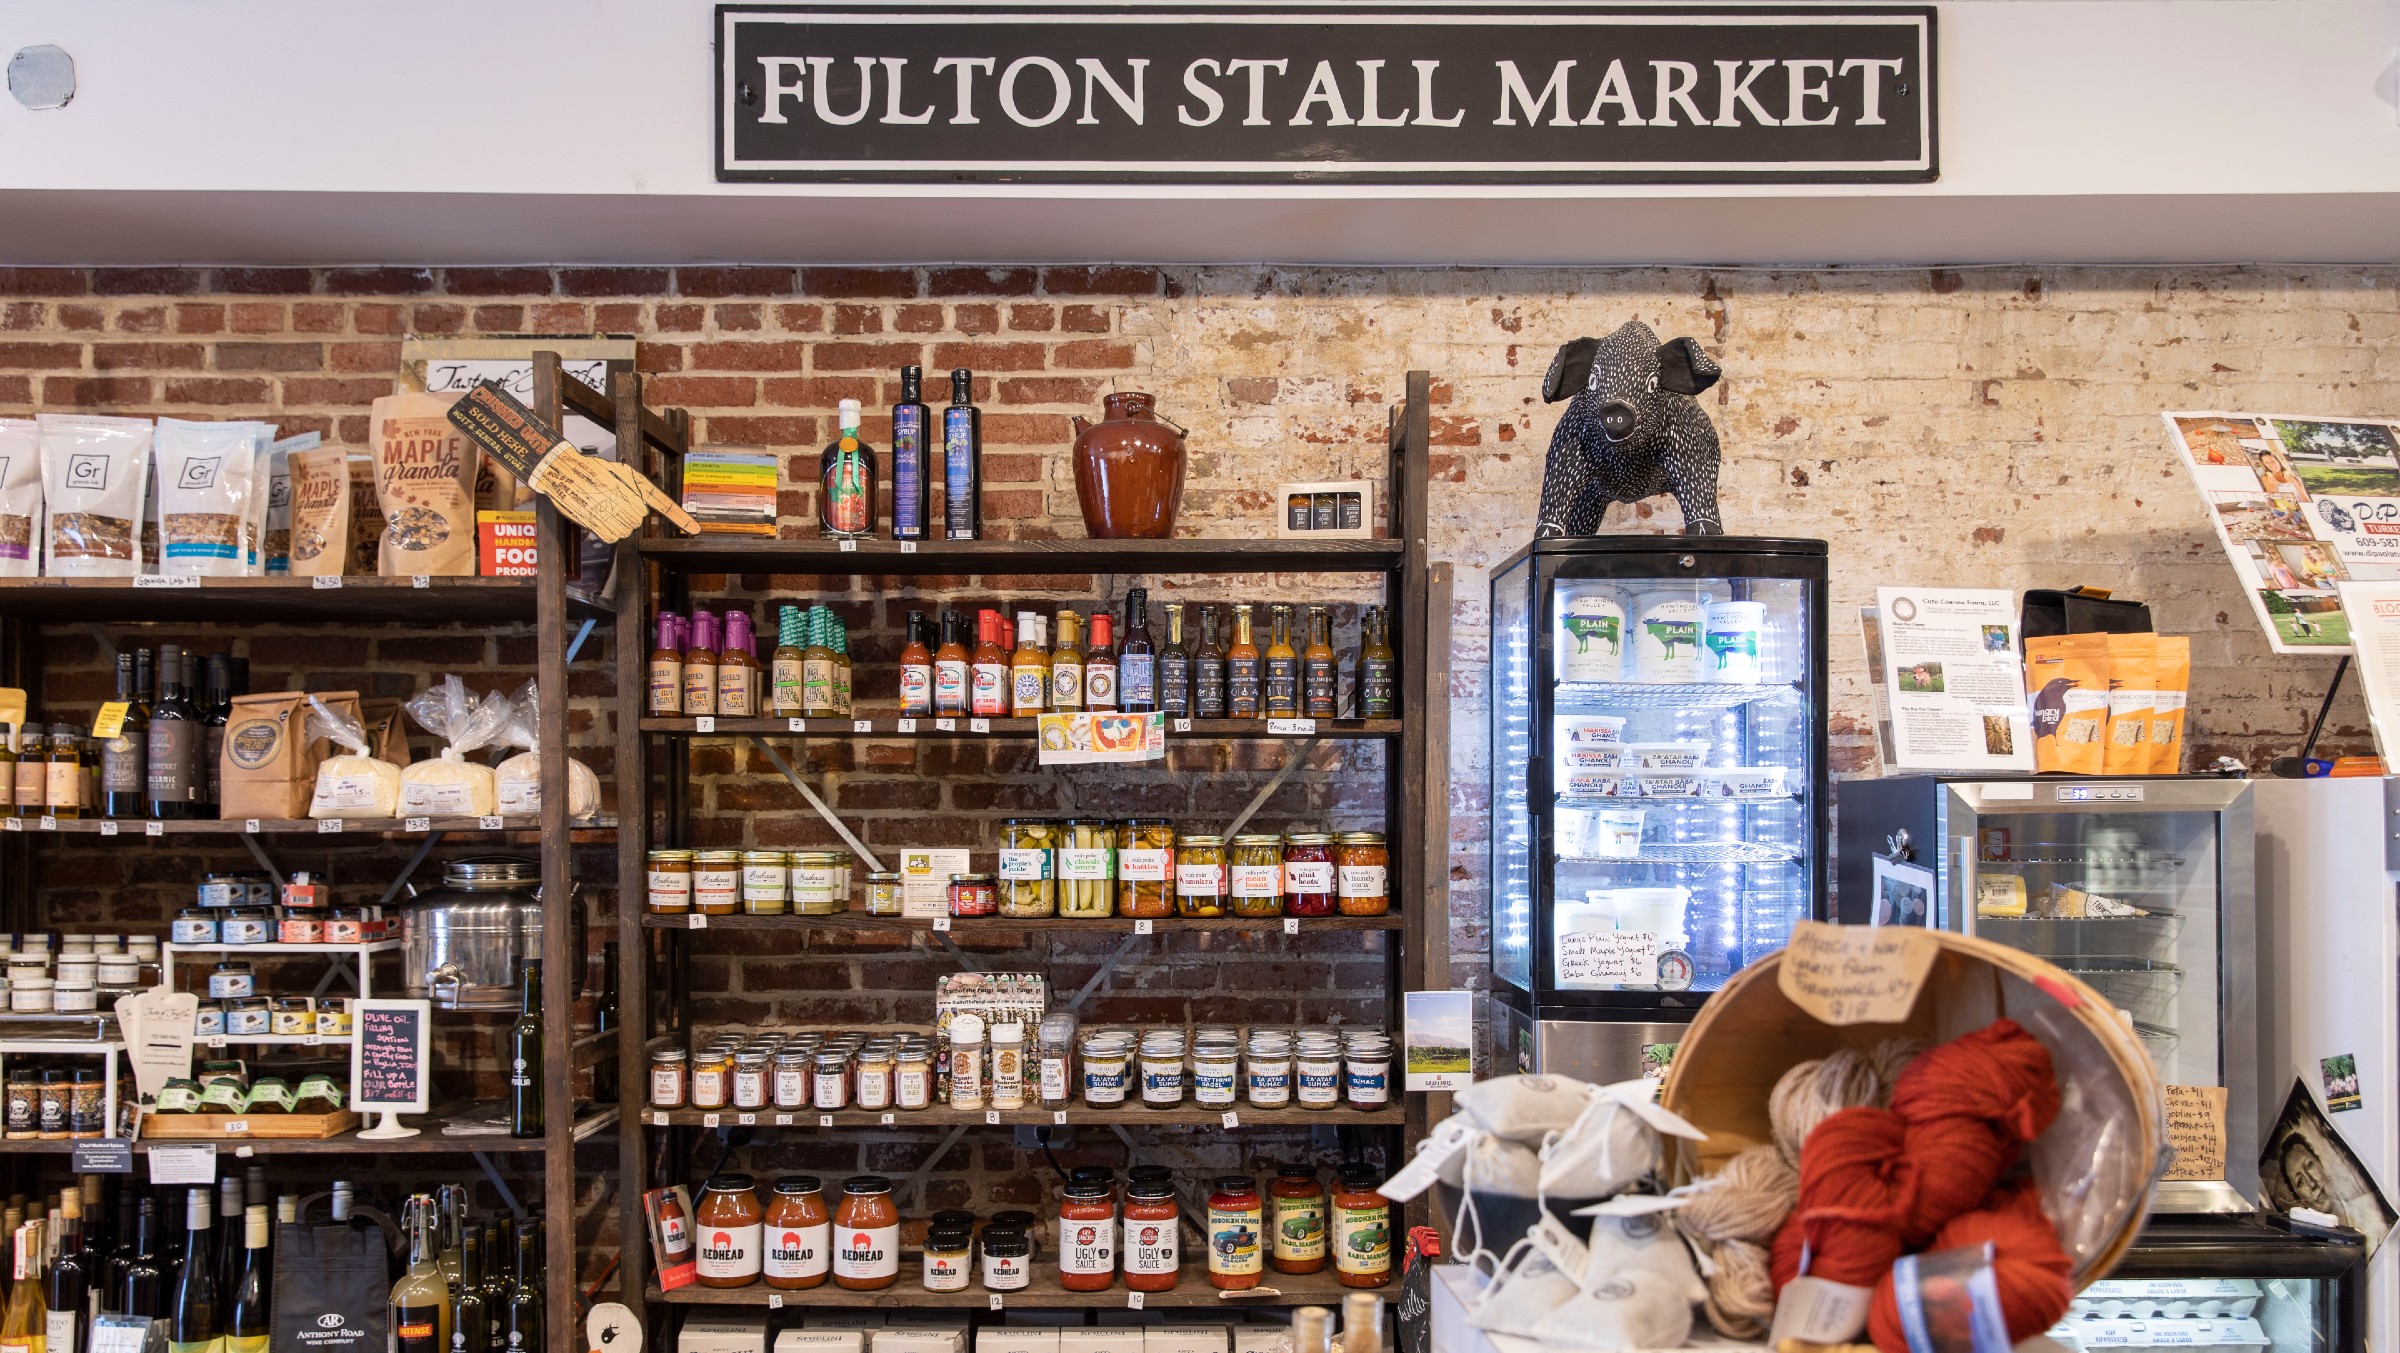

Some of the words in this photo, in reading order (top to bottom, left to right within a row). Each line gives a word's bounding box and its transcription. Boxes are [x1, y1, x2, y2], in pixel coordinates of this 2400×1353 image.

[756, 56, 1150, 127] FULTON
[1178, 57, 1466, 128] STALL
[1493, 58, 1904, 129] MARKET
[470, 386, 528, 438] CRUSHED
[521, 424, 552, 456] OATS
[404, 429, 421, 439] NEW
[423, 428, 442, 437] YORK
[469, 406, 500, 434] SOLD
[497, 429, 530, 459] HERE
[383, 437, 460, 464] MAPLE
[475, 428, 503, 455] GENERAL
[504, 452, 527, 473] STORE
[75, 462, 100, 479] Gr
[188, 465, 212, 480] Gr
[382, 453, 460, 495] granola
[272, 481, 288, 498] Gr
[300, 478, 340, 498] MAPLE
[494, 524, 536, 537] UNIQ
[2367, 525, 2400, 534] TURKE
[494, 539, 536, 547] HANDM
[903, 542, 913, 551] 18
[496, 549, 537, 564] FOO
[496, 567, 537, 576] PRODU
[169, 576, 183, 586] Lab
[315, 578, 340, 587] $4.50
[2035, 708, 2060, 718] hungry
[1178, 721, 1190, 730] 10
[2072, 789, 2088, 800] 39
[248, 821, 259, 831] $8
[320, 821, 341, 831] $3.25
[407, 820, 429, 829] $3.25
[481, 818, 500, 828] $6.50
[1562, 936, 1586, 947] Large
[1588, 932, 1610, 942] Plain
[1612, 933, 1640, 944] Yogurt
[1562, 946, 1586, 956] Small
[1590, 946, 1616, 956] Maple
[1618, 946, 1645, 958] Yogurt
[1562, 970, 1585, 978] Baba
[1630, 968, 1642, 976] $6
[211, 1038, 224, 1046] 20
[306, 1036, 319, 1044] 20
[2190, 1087, 2203, 1098] $11
[2201, 1100, 2212, 1110] $11
[707, 1117, 716, 1125] 10
[2198, 1112, 2210, 1120] $9
[230, 1122, 242, 1131] 30
[2202, 1134, 2217, 1146] $14
[2200, 1146, 2216, 1156] $14
[2200, 1168, 2215, 1179] $7
[1279, 1204, 1308, 1212] HOBOKEN
[1345, 1214, 1372, 1224] HOBOKEN
[702, 1249, 744, 1260] REDHEAD
[772, 1248, 814, 1260] REDHEAD
[842, 1249, 884, 1261] REDHEAD
[1076, 1248, 1096, 1260] UGLY
[1138, 1248, 1160, 1260] UGLY
[1348, 1252, 1366, 1260] BASIL
[1076, 1260, 1096, 1268] SAUCE
[1138, 1260, 1160, 1268] SAUCE
[993, 1268, 1020, 1276] REDHEAD
[991, 1296, 1002, 1305] 12
[1132, 1295, 1142, 1304] 10
[323, 1316, 339, 1326] AR
[297, 1330, 339, 1340] ANTHONY
[340, 1328, 364, 1338] ROAD
[399, 1325, 430, 1336] INTENSE
